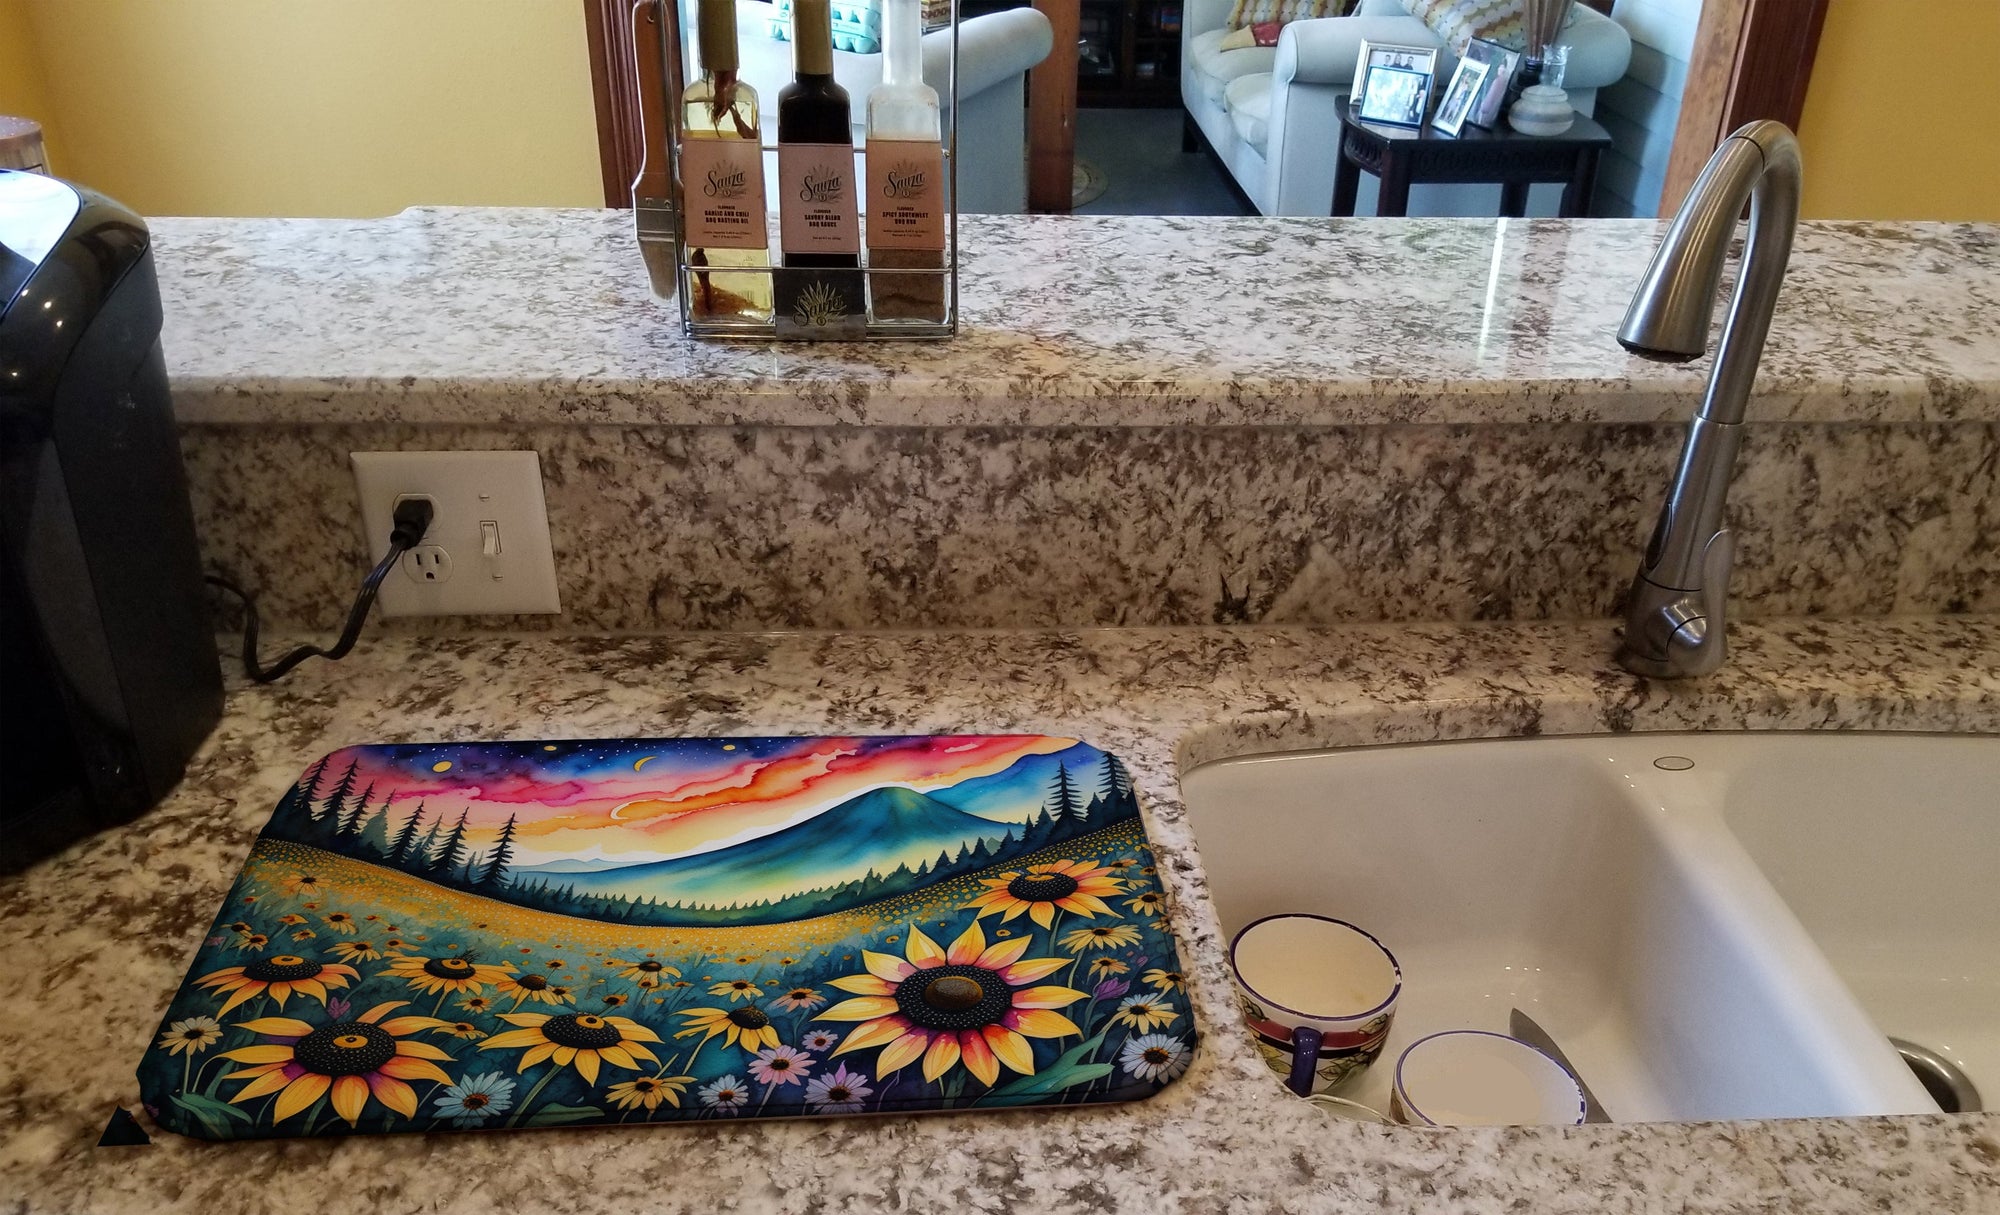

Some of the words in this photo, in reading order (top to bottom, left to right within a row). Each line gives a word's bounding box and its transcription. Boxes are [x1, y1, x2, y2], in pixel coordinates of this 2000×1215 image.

[703, 170, 747, 197] Sauza
[799, 175, 843, 202] Sauza
[884, 170, 926, 198] Sauza
